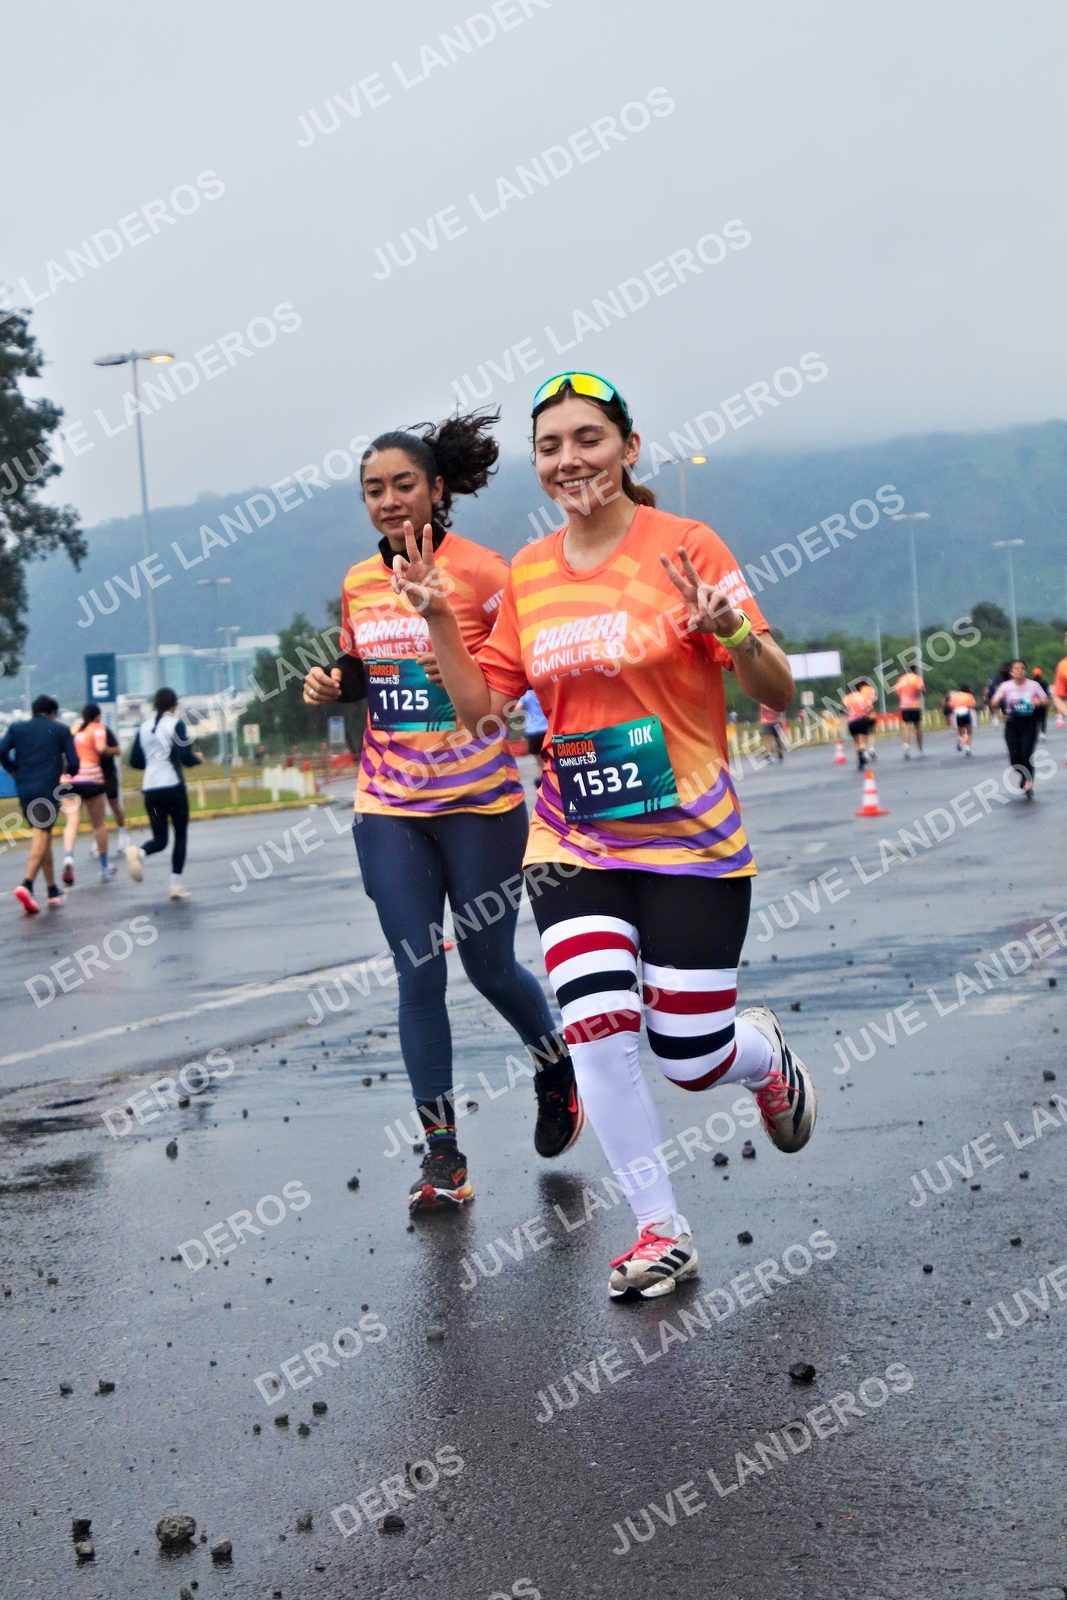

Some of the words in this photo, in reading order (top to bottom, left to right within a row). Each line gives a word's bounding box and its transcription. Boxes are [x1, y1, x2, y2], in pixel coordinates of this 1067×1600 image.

[533, 610, 627, 656] CARRERA
[369, 665, 400, 676] CARRERA
[91, 674, 110, 697] E
[379, 689, 429, 710] 1125
[628, 724, 653, 747] 10K
[557, 739, 595, 757] CARRERA
[573, 762, 643, 797] 1532
